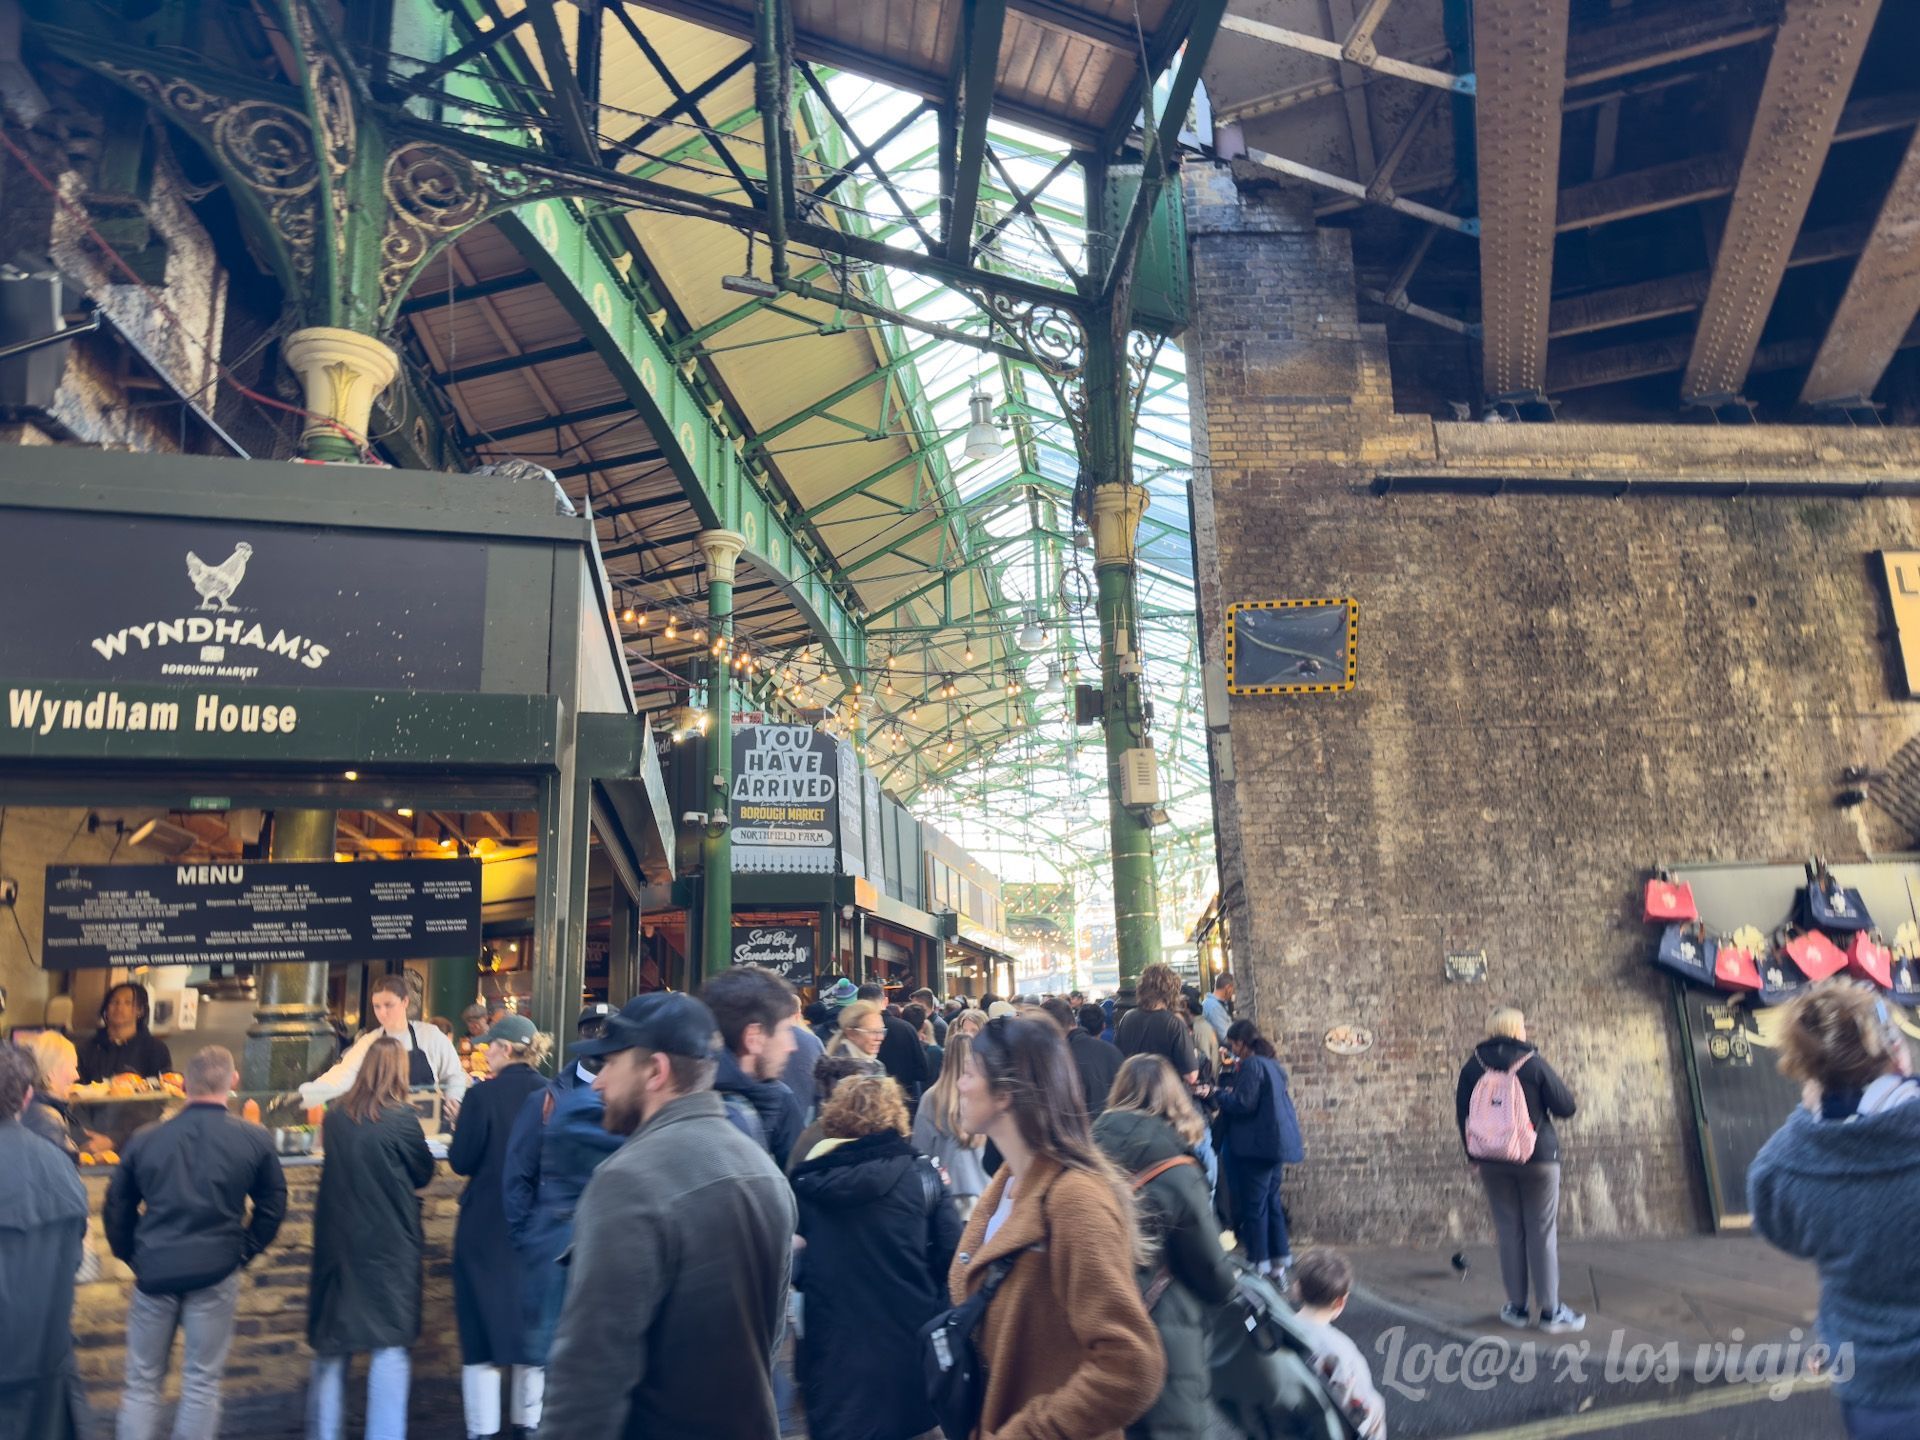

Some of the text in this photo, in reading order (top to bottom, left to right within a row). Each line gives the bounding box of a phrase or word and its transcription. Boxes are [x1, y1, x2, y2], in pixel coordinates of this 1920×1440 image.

[91, 617, 330, 669] WYNDHAM'S
[161, 664, 259, 678] BOROUGH MARKET
[9, 689, 297, 735] Wyndham House
[759, 729, 810, 749] YOU
[749, 753, 819, 773] HAVE
[736, 777, 832, 798] ARRIVED
[740, 806, 826, 822] BOROUGH MARKET
[740, 830, 825, 843] NORTHFIELD FARM
[176, 865, 244, 886] MENU
[747, 929, 773, 947] Salt
[150, 954, 174, 964] CHEESE
[200, 953, 210, 962] TO
[210, 952, 224, 962] ANY
[224, 952, 234, 961] OF
[235, 951, 247, 961] THE
[248, 951, 270, 961] ABOVE
[287, 950, 305, 959] EACH
[734, 944, 796, 963] Sandwich
